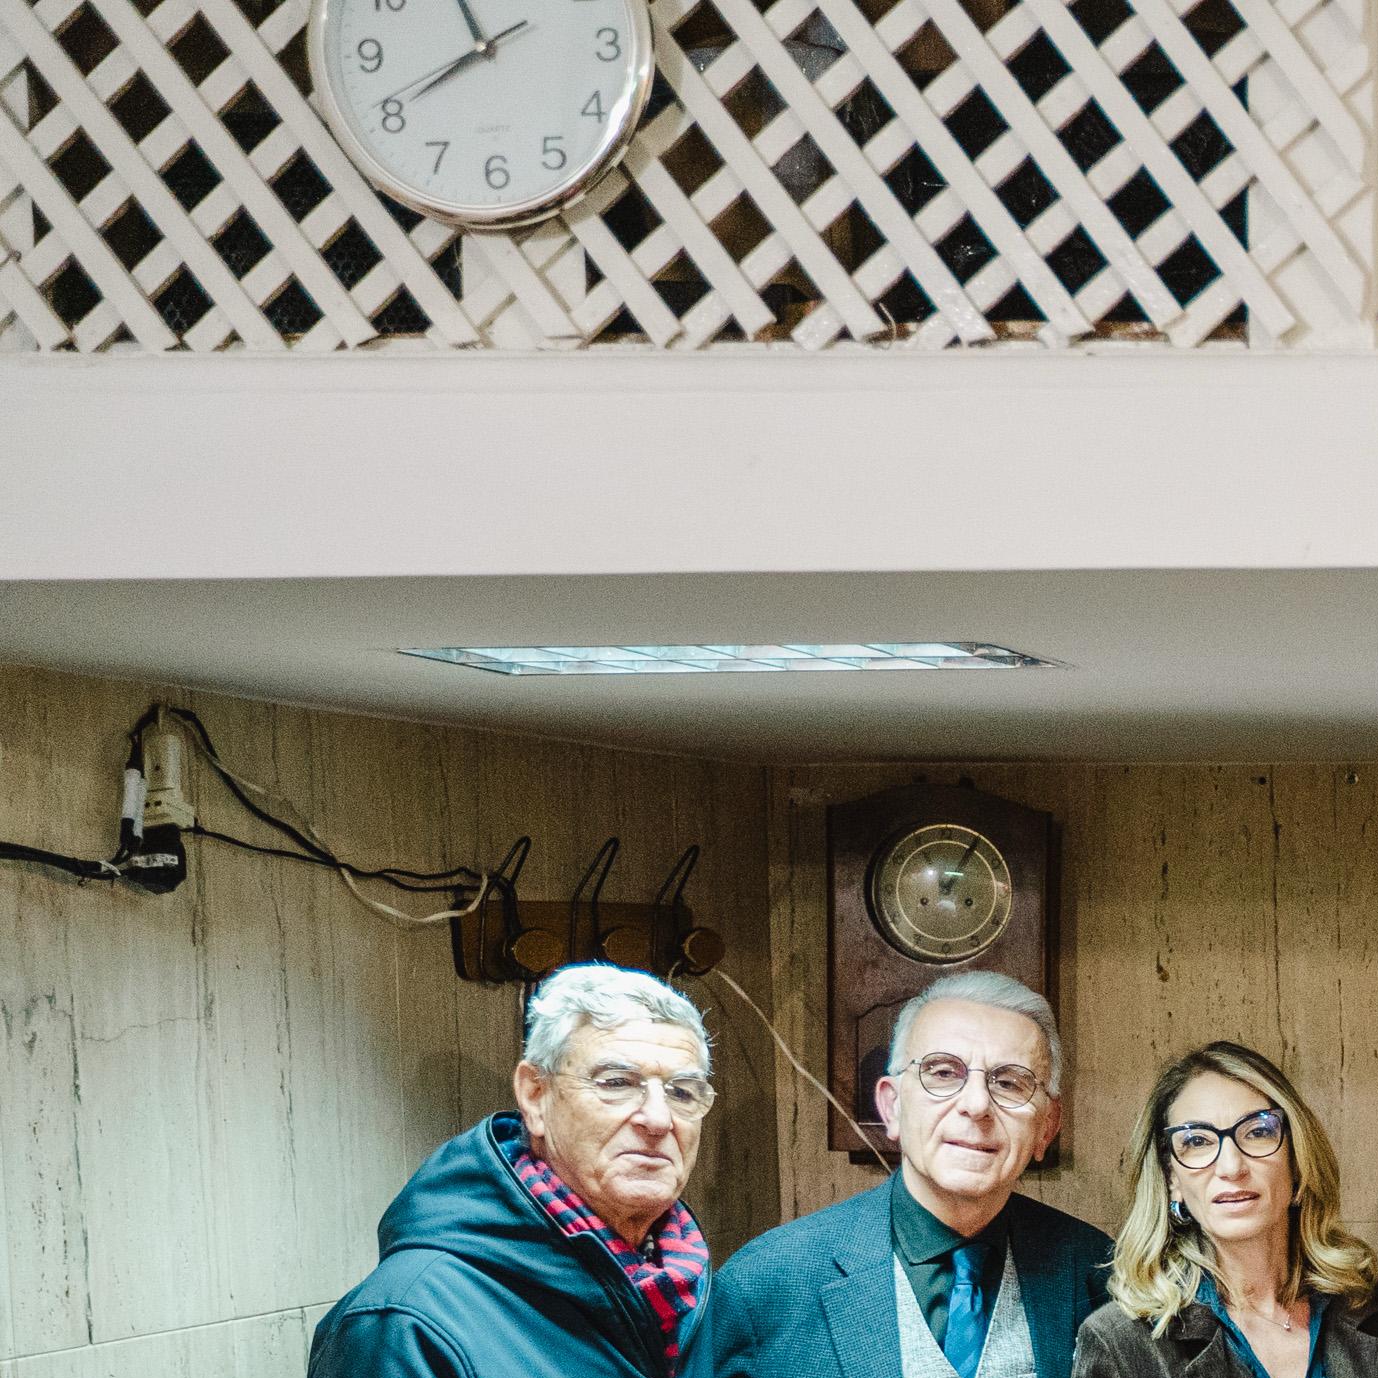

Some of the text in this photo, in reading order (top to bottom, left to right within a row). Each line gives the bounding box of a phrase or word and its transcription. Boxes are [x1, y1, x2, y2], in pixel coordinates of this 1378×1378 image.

[357, 38, 384, 73] 9
[595, 27, 622, 62] 3
[381, 98, 406, 134] 8
[580, 90, 607, 124] 4
[425, 141, 450, 176] 7
[541, 136, 568, 171] 5
[484, 155, 511, 190] 6
